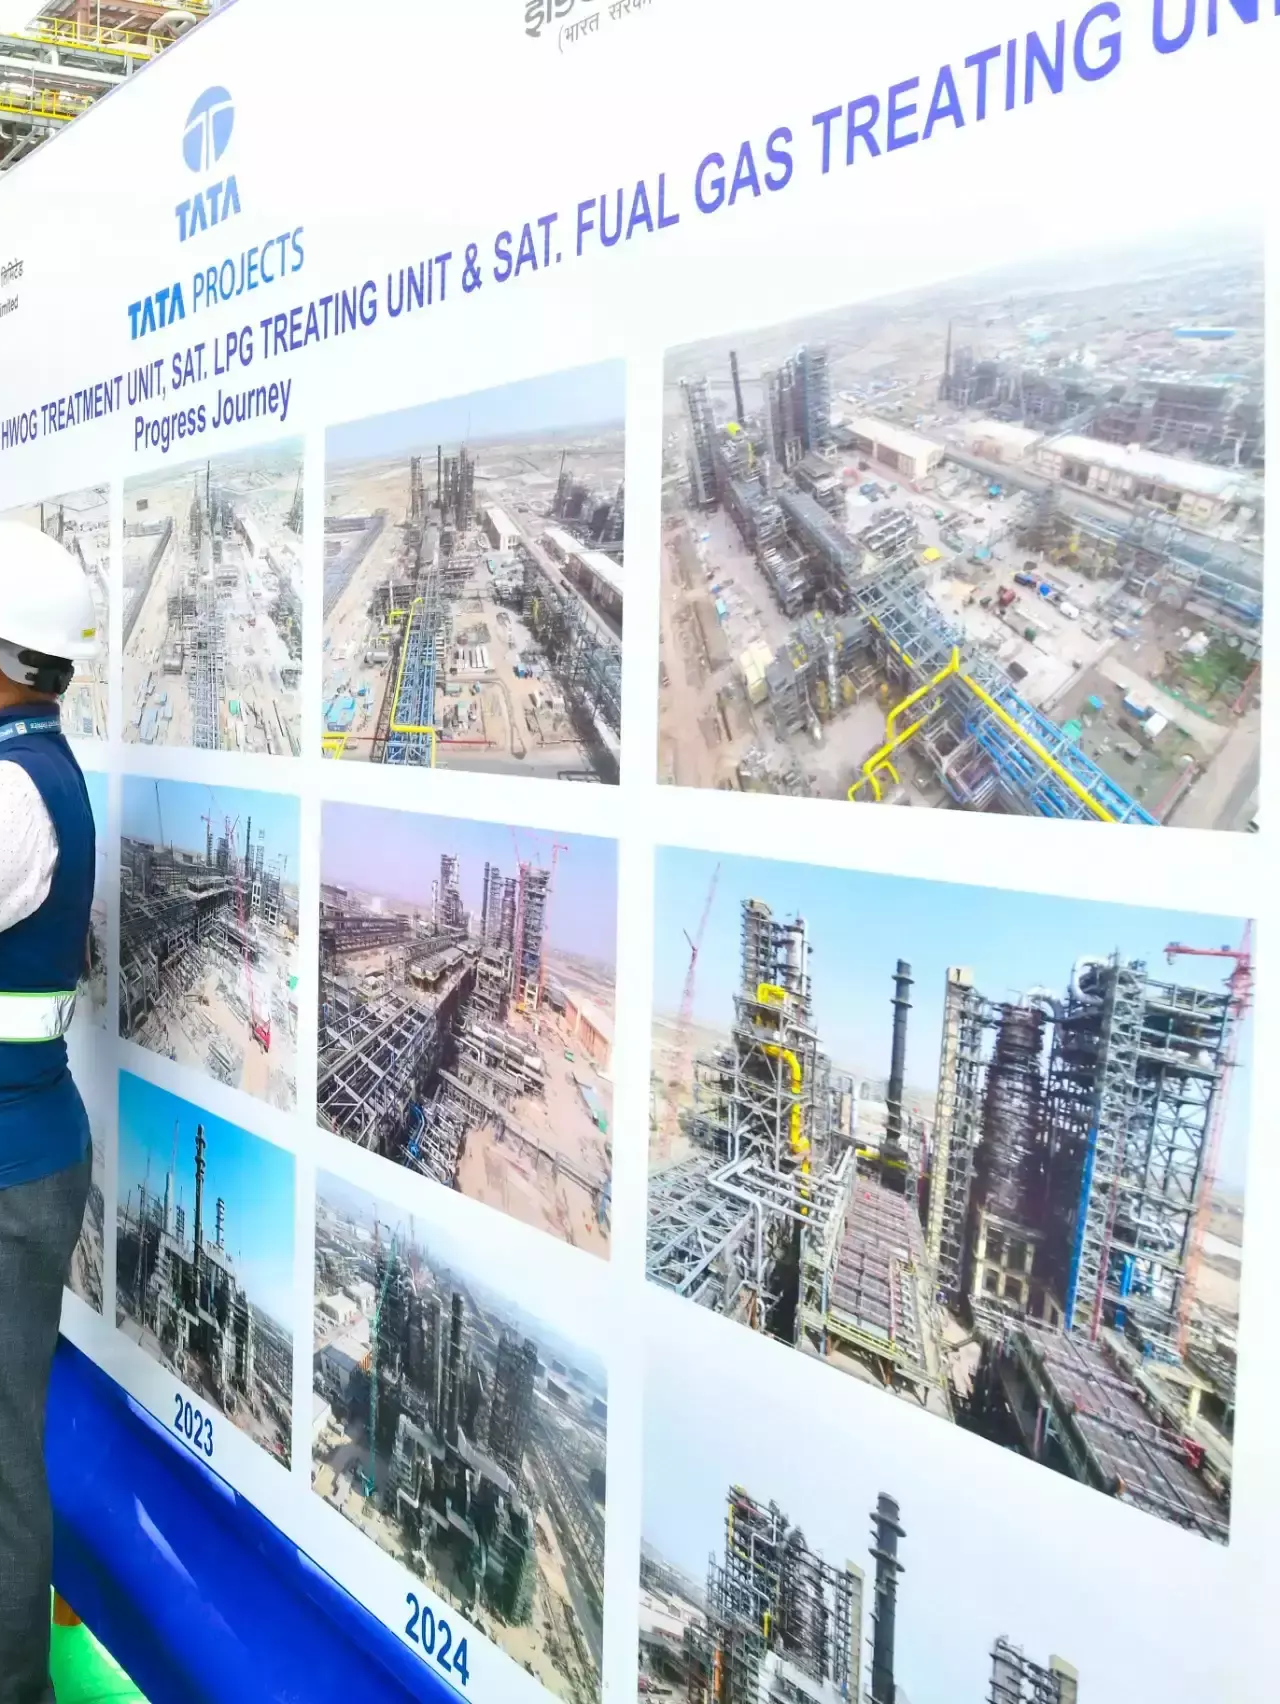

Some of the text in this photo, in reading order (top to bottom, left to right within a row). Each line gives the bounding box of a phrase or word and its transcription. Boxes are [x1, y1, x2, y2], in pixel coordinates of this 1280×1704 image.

[1, 408, 38, 450] HWOG
[41, 375, 123, 436] TREATMENT
[127, 358, 166, 401] UNIT,
[172, 342, 207, 390] SAT.
[214, 325, 253, 376] LPG
[260, 279, 377, 360] TREATING
[387, 251, 452, 317] UNIT
[461, 242, 483, 294] &
[492, 212, 562, 282] SAT.
[575, 172, 680, 257] FUAL
[694, 126, 794, 216] GAS
[811, 1, 1121, 176] TREATING
[175, 174, 241, 243] TATA
[128, 226, 305, 340] TATA PROJECTS
[134, 378, 292, 454] Progress Journey
[174, 1393, 214, 1457] 2023
[405, 1592, 470, 1685] 2024
